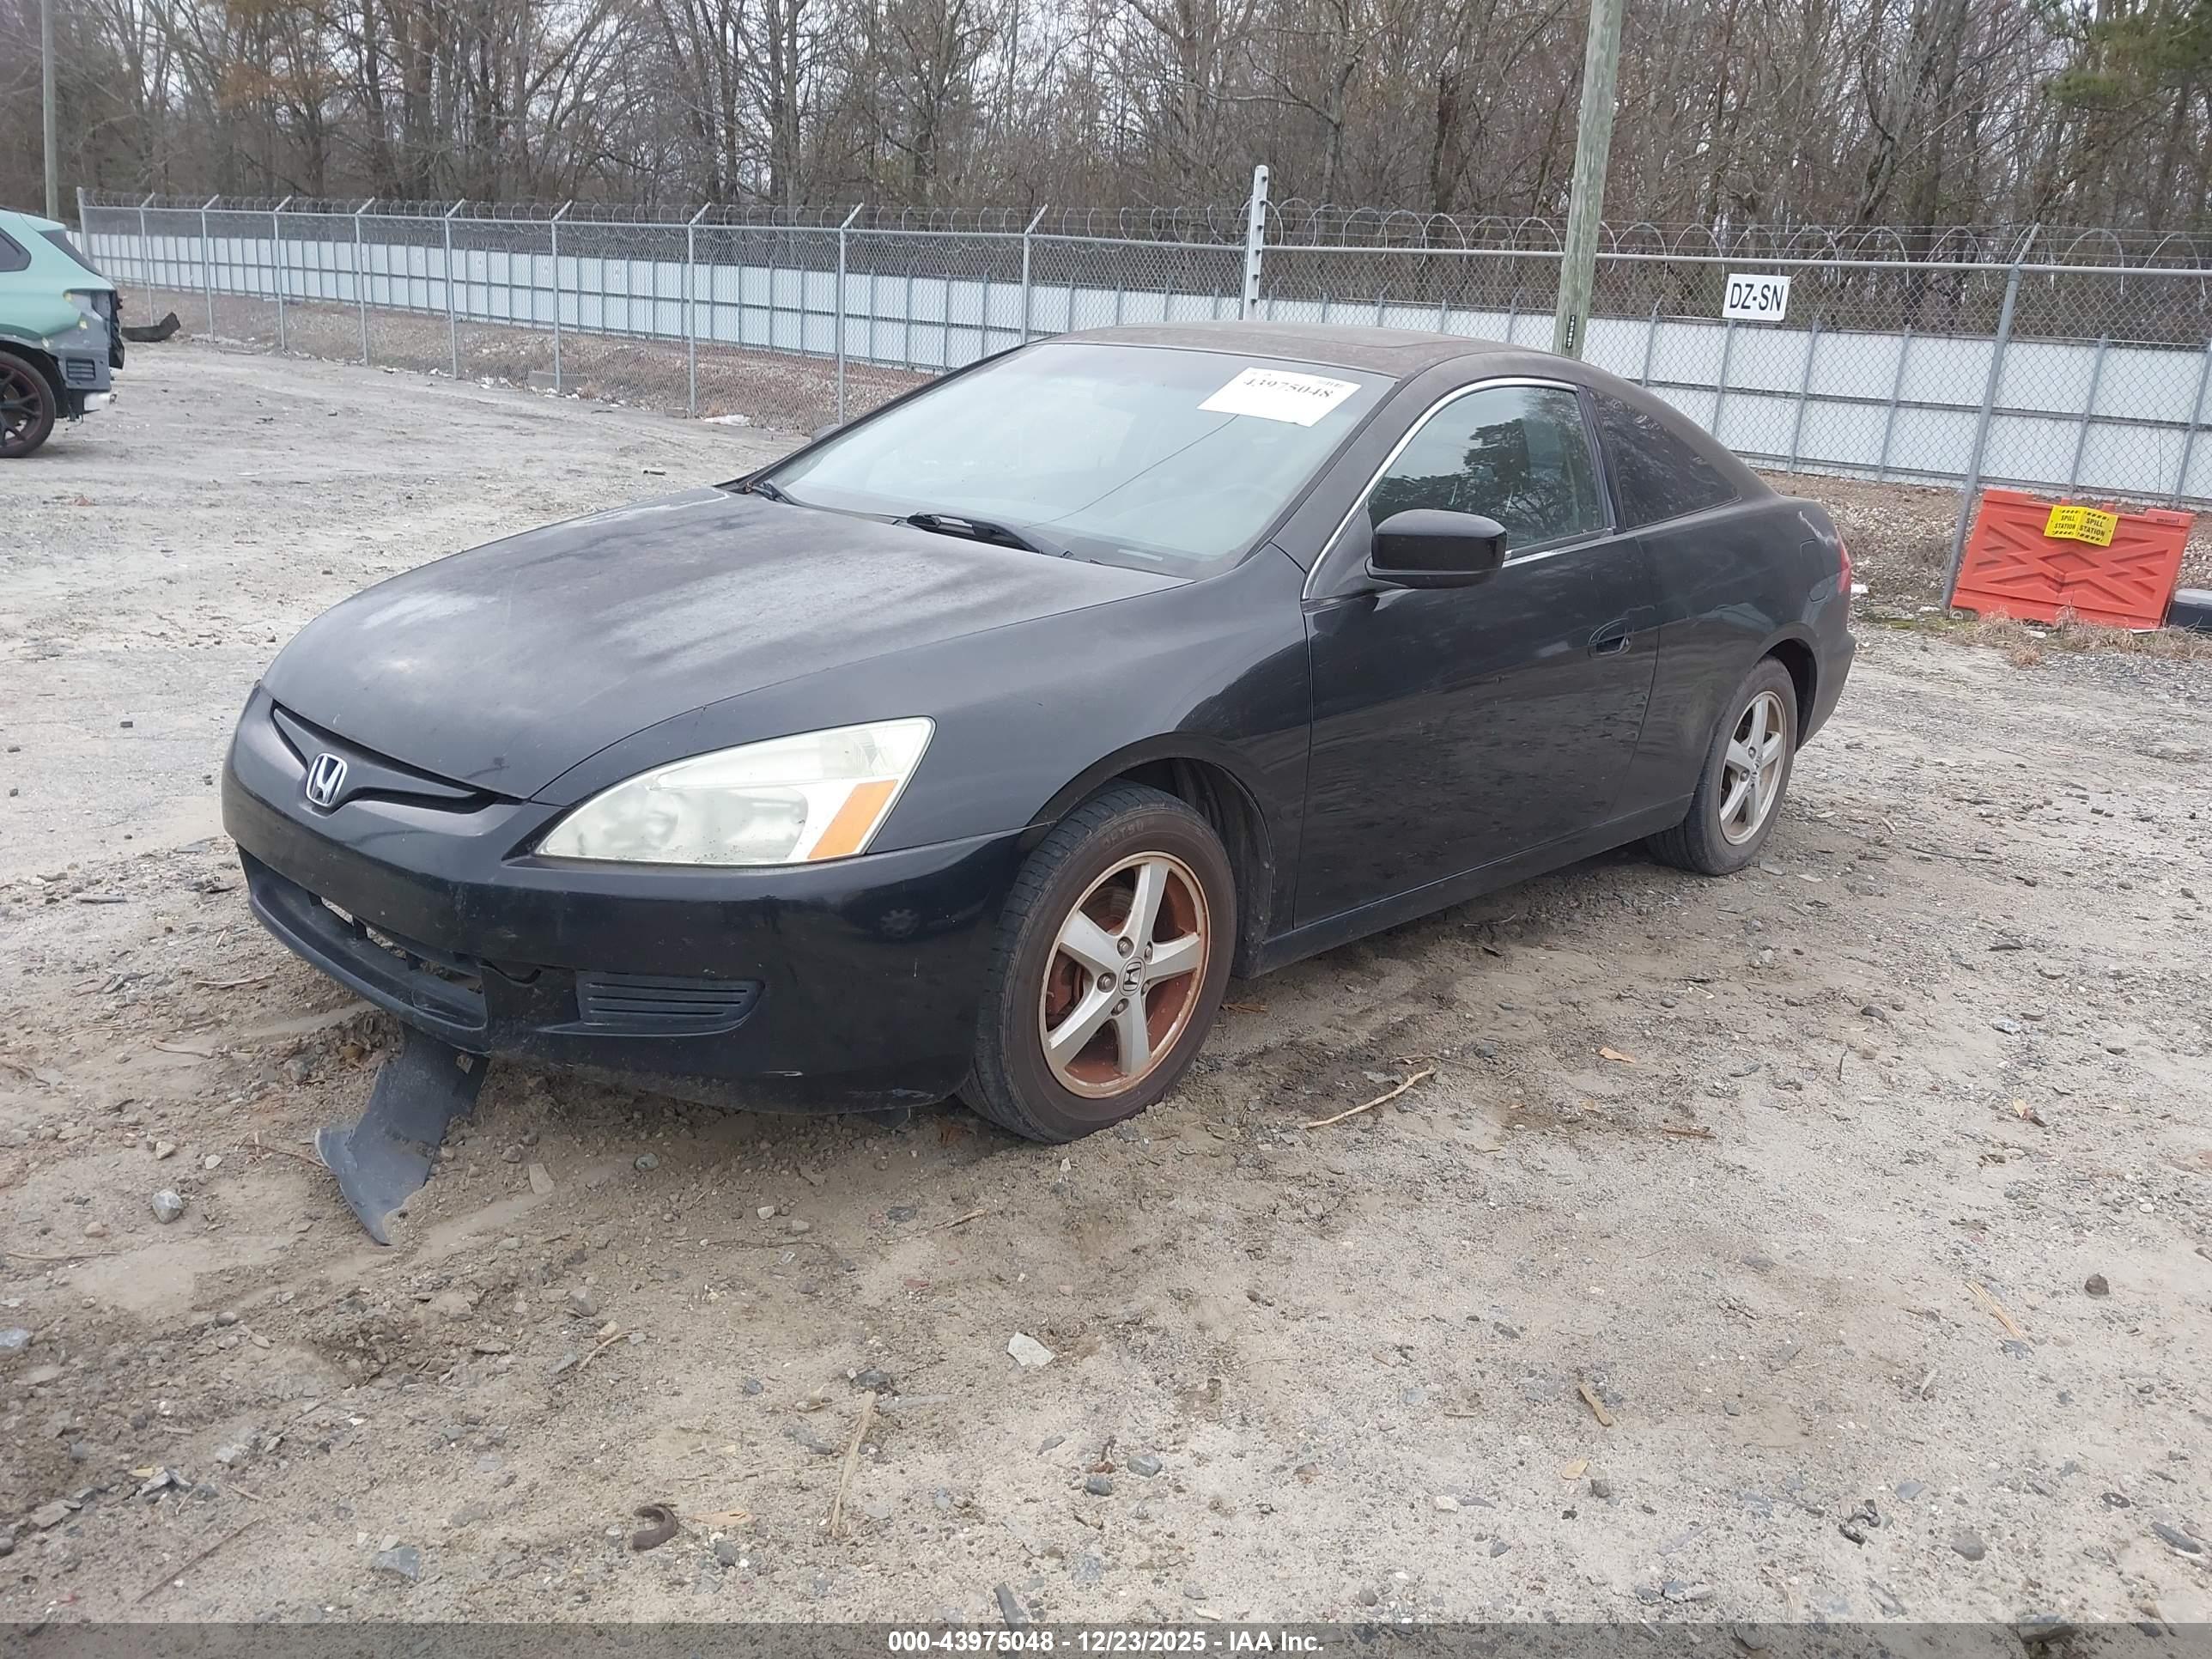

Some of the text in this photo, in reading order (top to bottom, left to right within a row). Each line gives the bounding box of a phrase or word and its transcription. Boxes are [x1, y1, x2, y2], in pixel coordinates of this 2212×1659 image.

[1729, 283, 1784, 312] DZ-SN
[2086, 518, 2103, 527] SPILL
[2079, 525, 2106, 537] STATION
